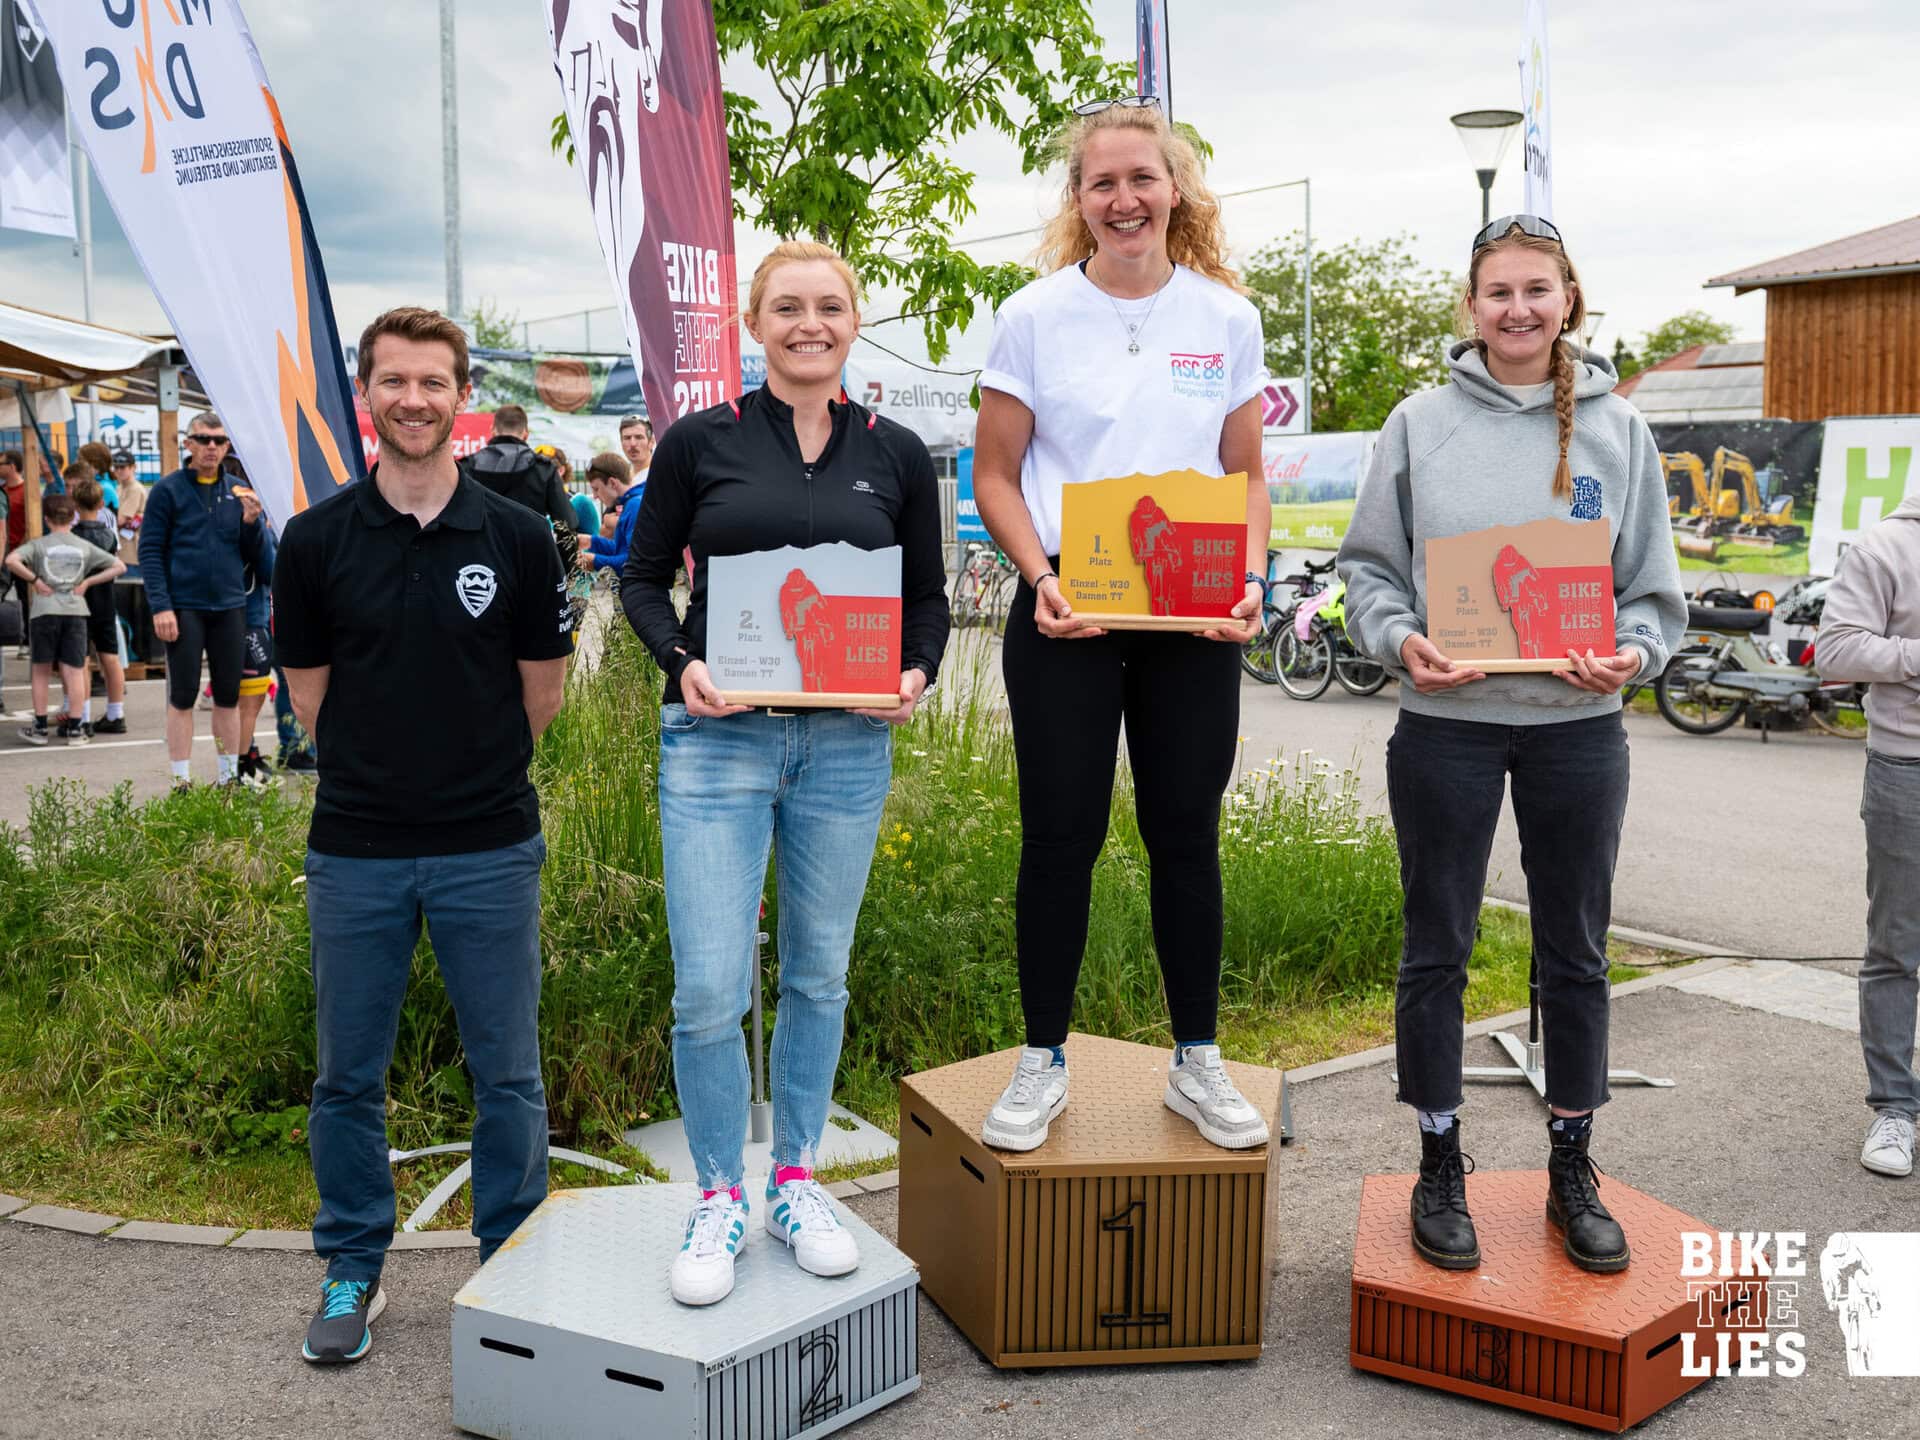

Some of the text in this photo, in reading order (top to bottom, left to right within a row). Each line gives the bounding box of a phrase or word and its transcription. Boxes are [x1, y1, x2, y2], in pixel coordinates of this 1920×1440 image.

[888, 384, 969, 416] zellinge
[1094, 535, 1109, 554] 1.
[1192, 539, 1236, 557] BIKE
[1089, 556, 1112, 566] Platz
[1070, 579, 1098, 588] Einzel
[1109, 580, 1130, 589] W30
[1192, 571, 1234, 588] LIES
[1076, 592, 1123, 601] Damen TT
[1457, 585, 1477, 604] 3.
[1558, 582, 1602, 599] BIKE
[739, 610, 760, 630] 2.
[1456, 607, 1479, 616] Platz
[845, 613, 890, 631] BIKE
[1560, 613, 1602, 630] LIES
[738, 633, 763, 642] Platz
[1437, 627, 1466, 638] Einzel
[1477, 627, 1498, 637] W30
[1444, 639, 1492, 649] Damen TT
[717, 656, 748, 665] Einzel
[758, 656, 781, 666] W30
[845, 647, 889, 663] LIES
[724, 668, 775, 679] Damen TT
[1100, 1200, 1170, 1329] 1
[1464, 1323, 1511, 1388] 3
[799, 1333, 843, 1426] 2
